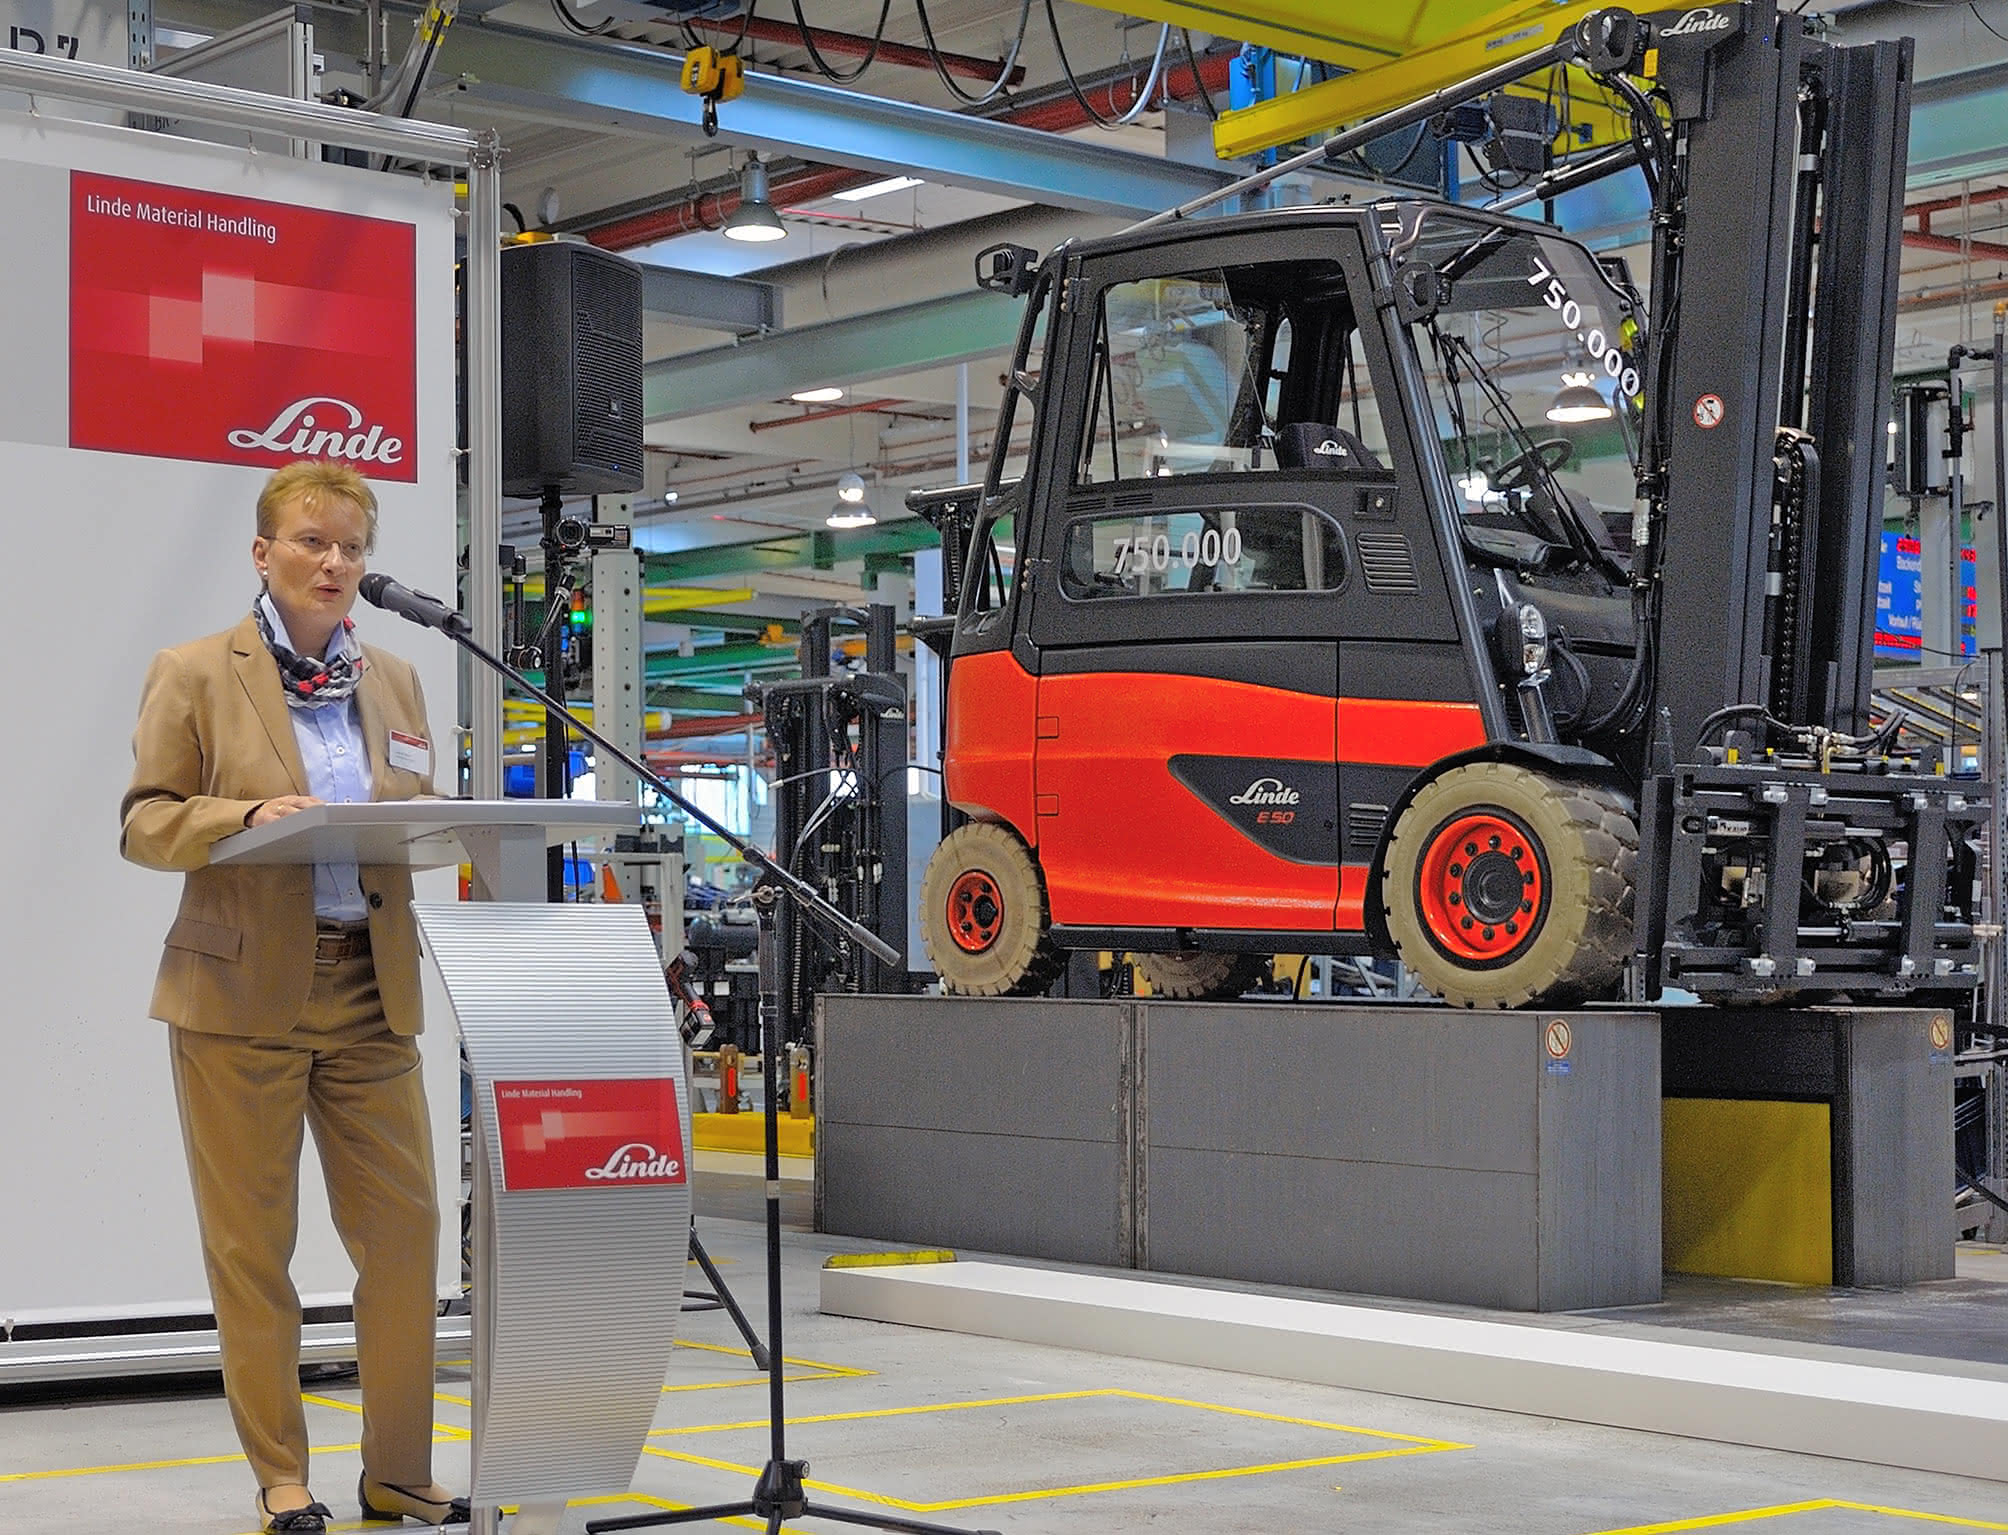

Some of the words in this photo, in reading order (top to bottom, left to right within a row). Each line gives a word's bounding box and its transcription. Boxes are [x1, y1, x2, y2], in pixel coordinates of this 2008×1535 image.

[1660, 8, 1729, 37] Linde
[87, 195, 132, 218] Linde
[136, 203, 202, 229] Material
[207, 213, 276, 244] Handling
[1527, 256, 1640, 397] 750.000
[227, 397, 403, 464] Linde
[1313, 440, 1348, 457] Linde
[1113, 527, 1242, 575] 750.000
[1229, 778, 1300, 805] Linde
[501, 1089, 521, 1099] Linde
[522, 1088, 550, 1098] Material
[551, 1088, 583, 1099] Handling
[585, 1143, 680, 1180] Linde
